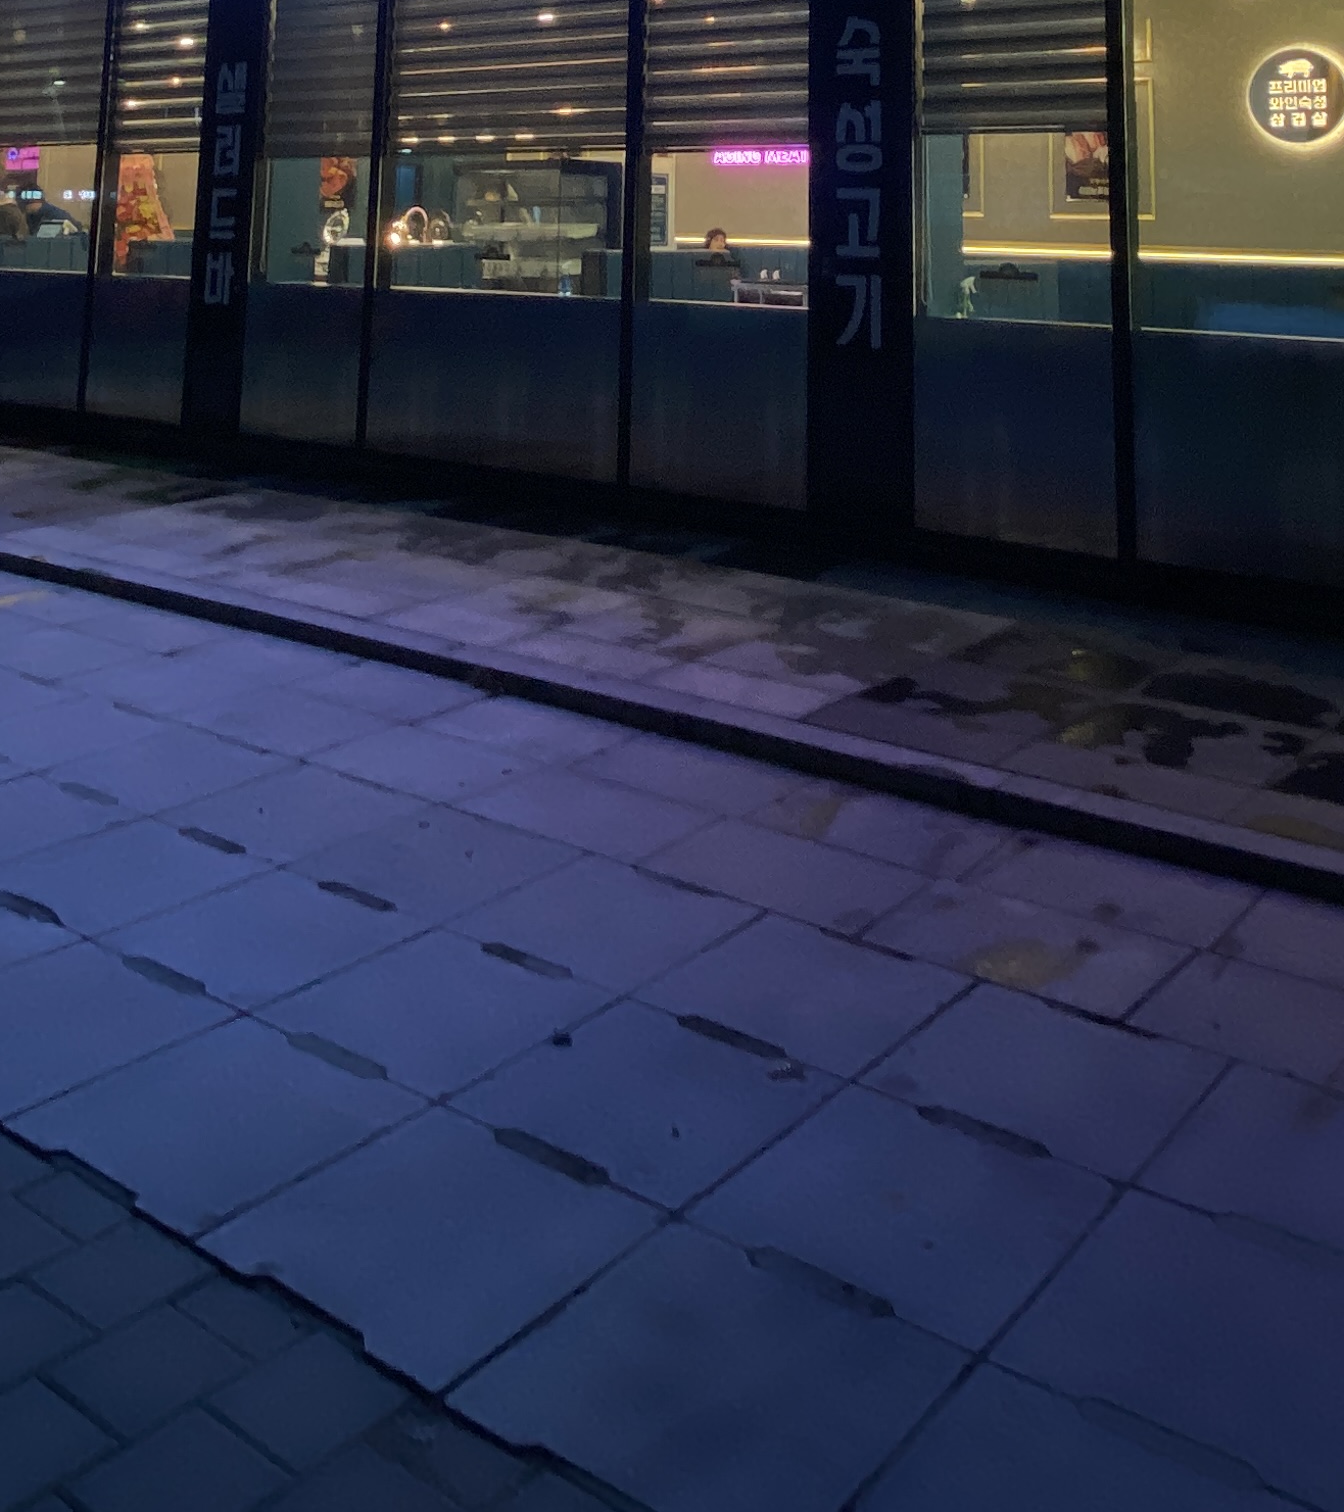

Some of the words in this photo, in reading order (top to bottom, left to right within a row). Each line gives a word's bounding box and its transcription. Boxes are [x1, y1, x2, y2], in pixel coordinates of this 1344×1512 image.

[1268, 78, 1327, 94] 프리미엄
[1268, 95, 1327, 110] 와인숙성
[203, 60, 248, 305] 샐러드바
[835, 15, 884, 350] 숙성고기
